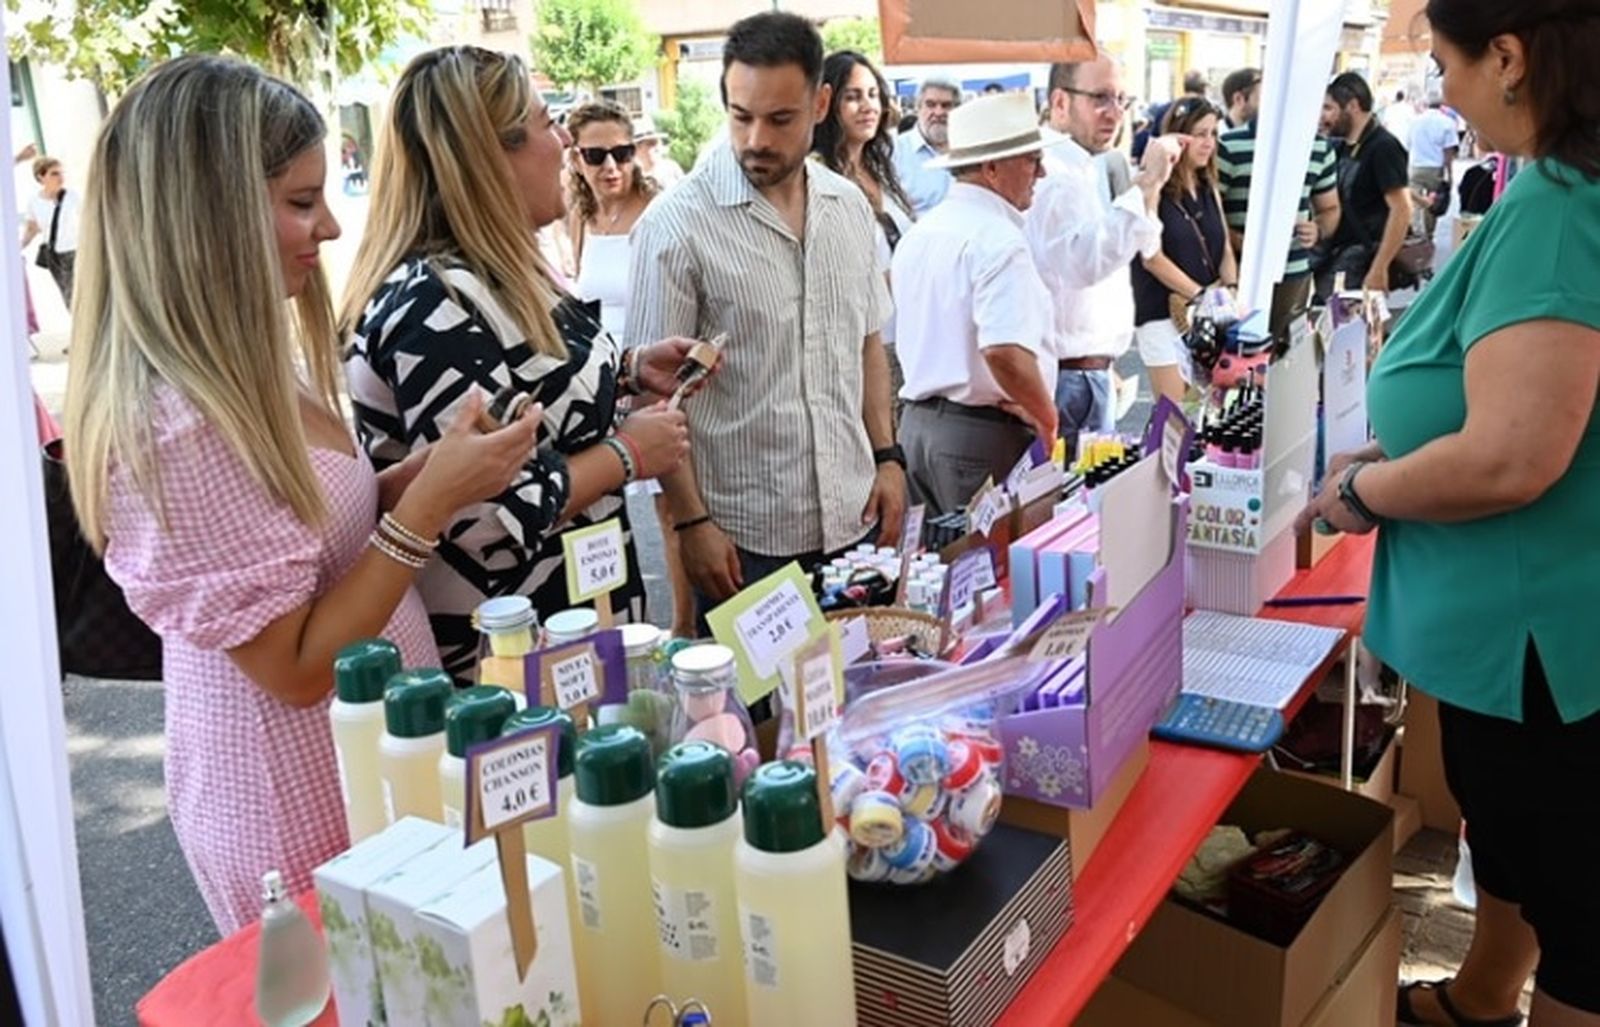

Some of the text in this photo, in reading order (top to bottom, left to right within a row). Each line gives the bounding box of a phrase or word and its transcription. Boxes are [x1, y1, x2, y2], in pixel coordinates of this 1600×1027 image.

[1196, 504, 1246, 527] COLOR
[609, 561, 617, 577] €
[558, 656, 589, 674] NIVEA
[483, 744, 543, 776] COLONIAS
[484, 762, 542, 793] CHANSON
[502, 781, 540, 812] 4,0 €
